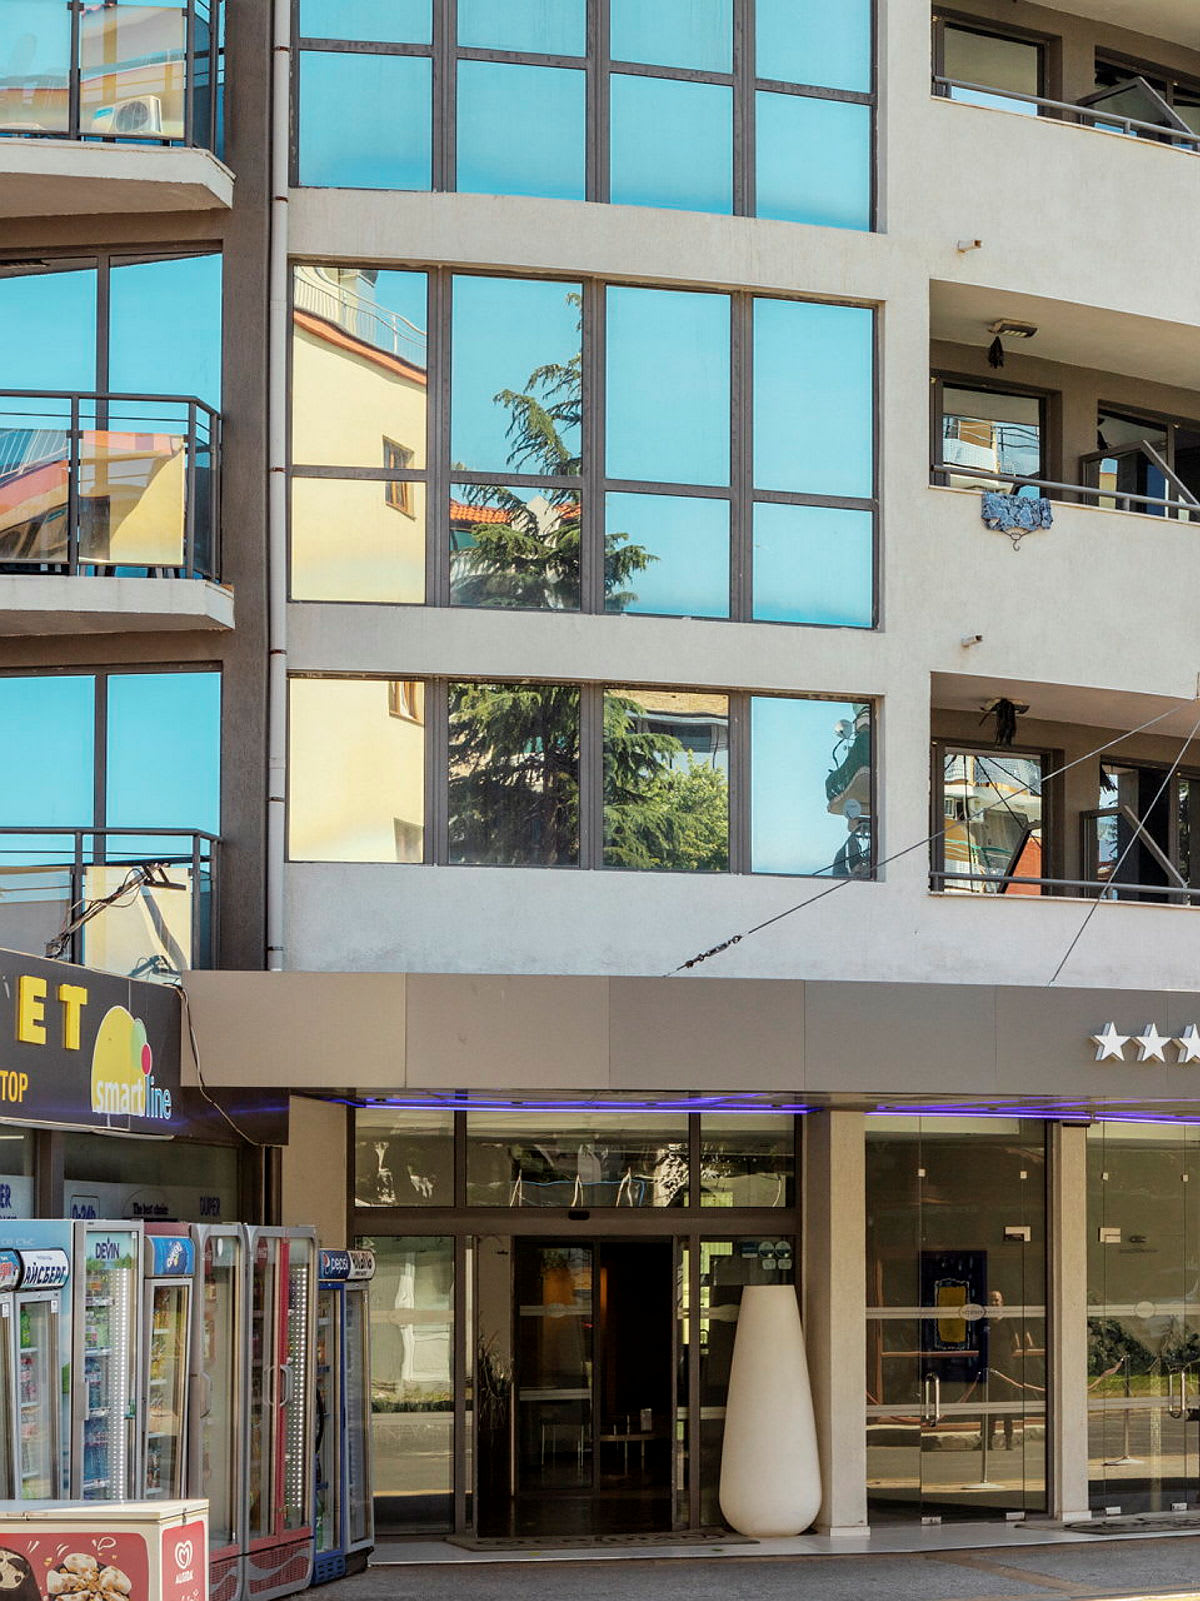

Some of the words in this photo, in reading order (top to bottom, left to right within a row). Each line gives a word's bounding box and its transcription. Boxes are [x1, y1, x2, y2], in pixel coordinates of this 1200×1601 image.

[18, 975, 88, 1050] ET
[0, 1070, 28, 1102] TOP
[95, 1242, 120, 1259] DEVIN
[24, 1262, 66, 1284] АЙСБЕРГ
[331, 1257, 349, 1275] pepsi
